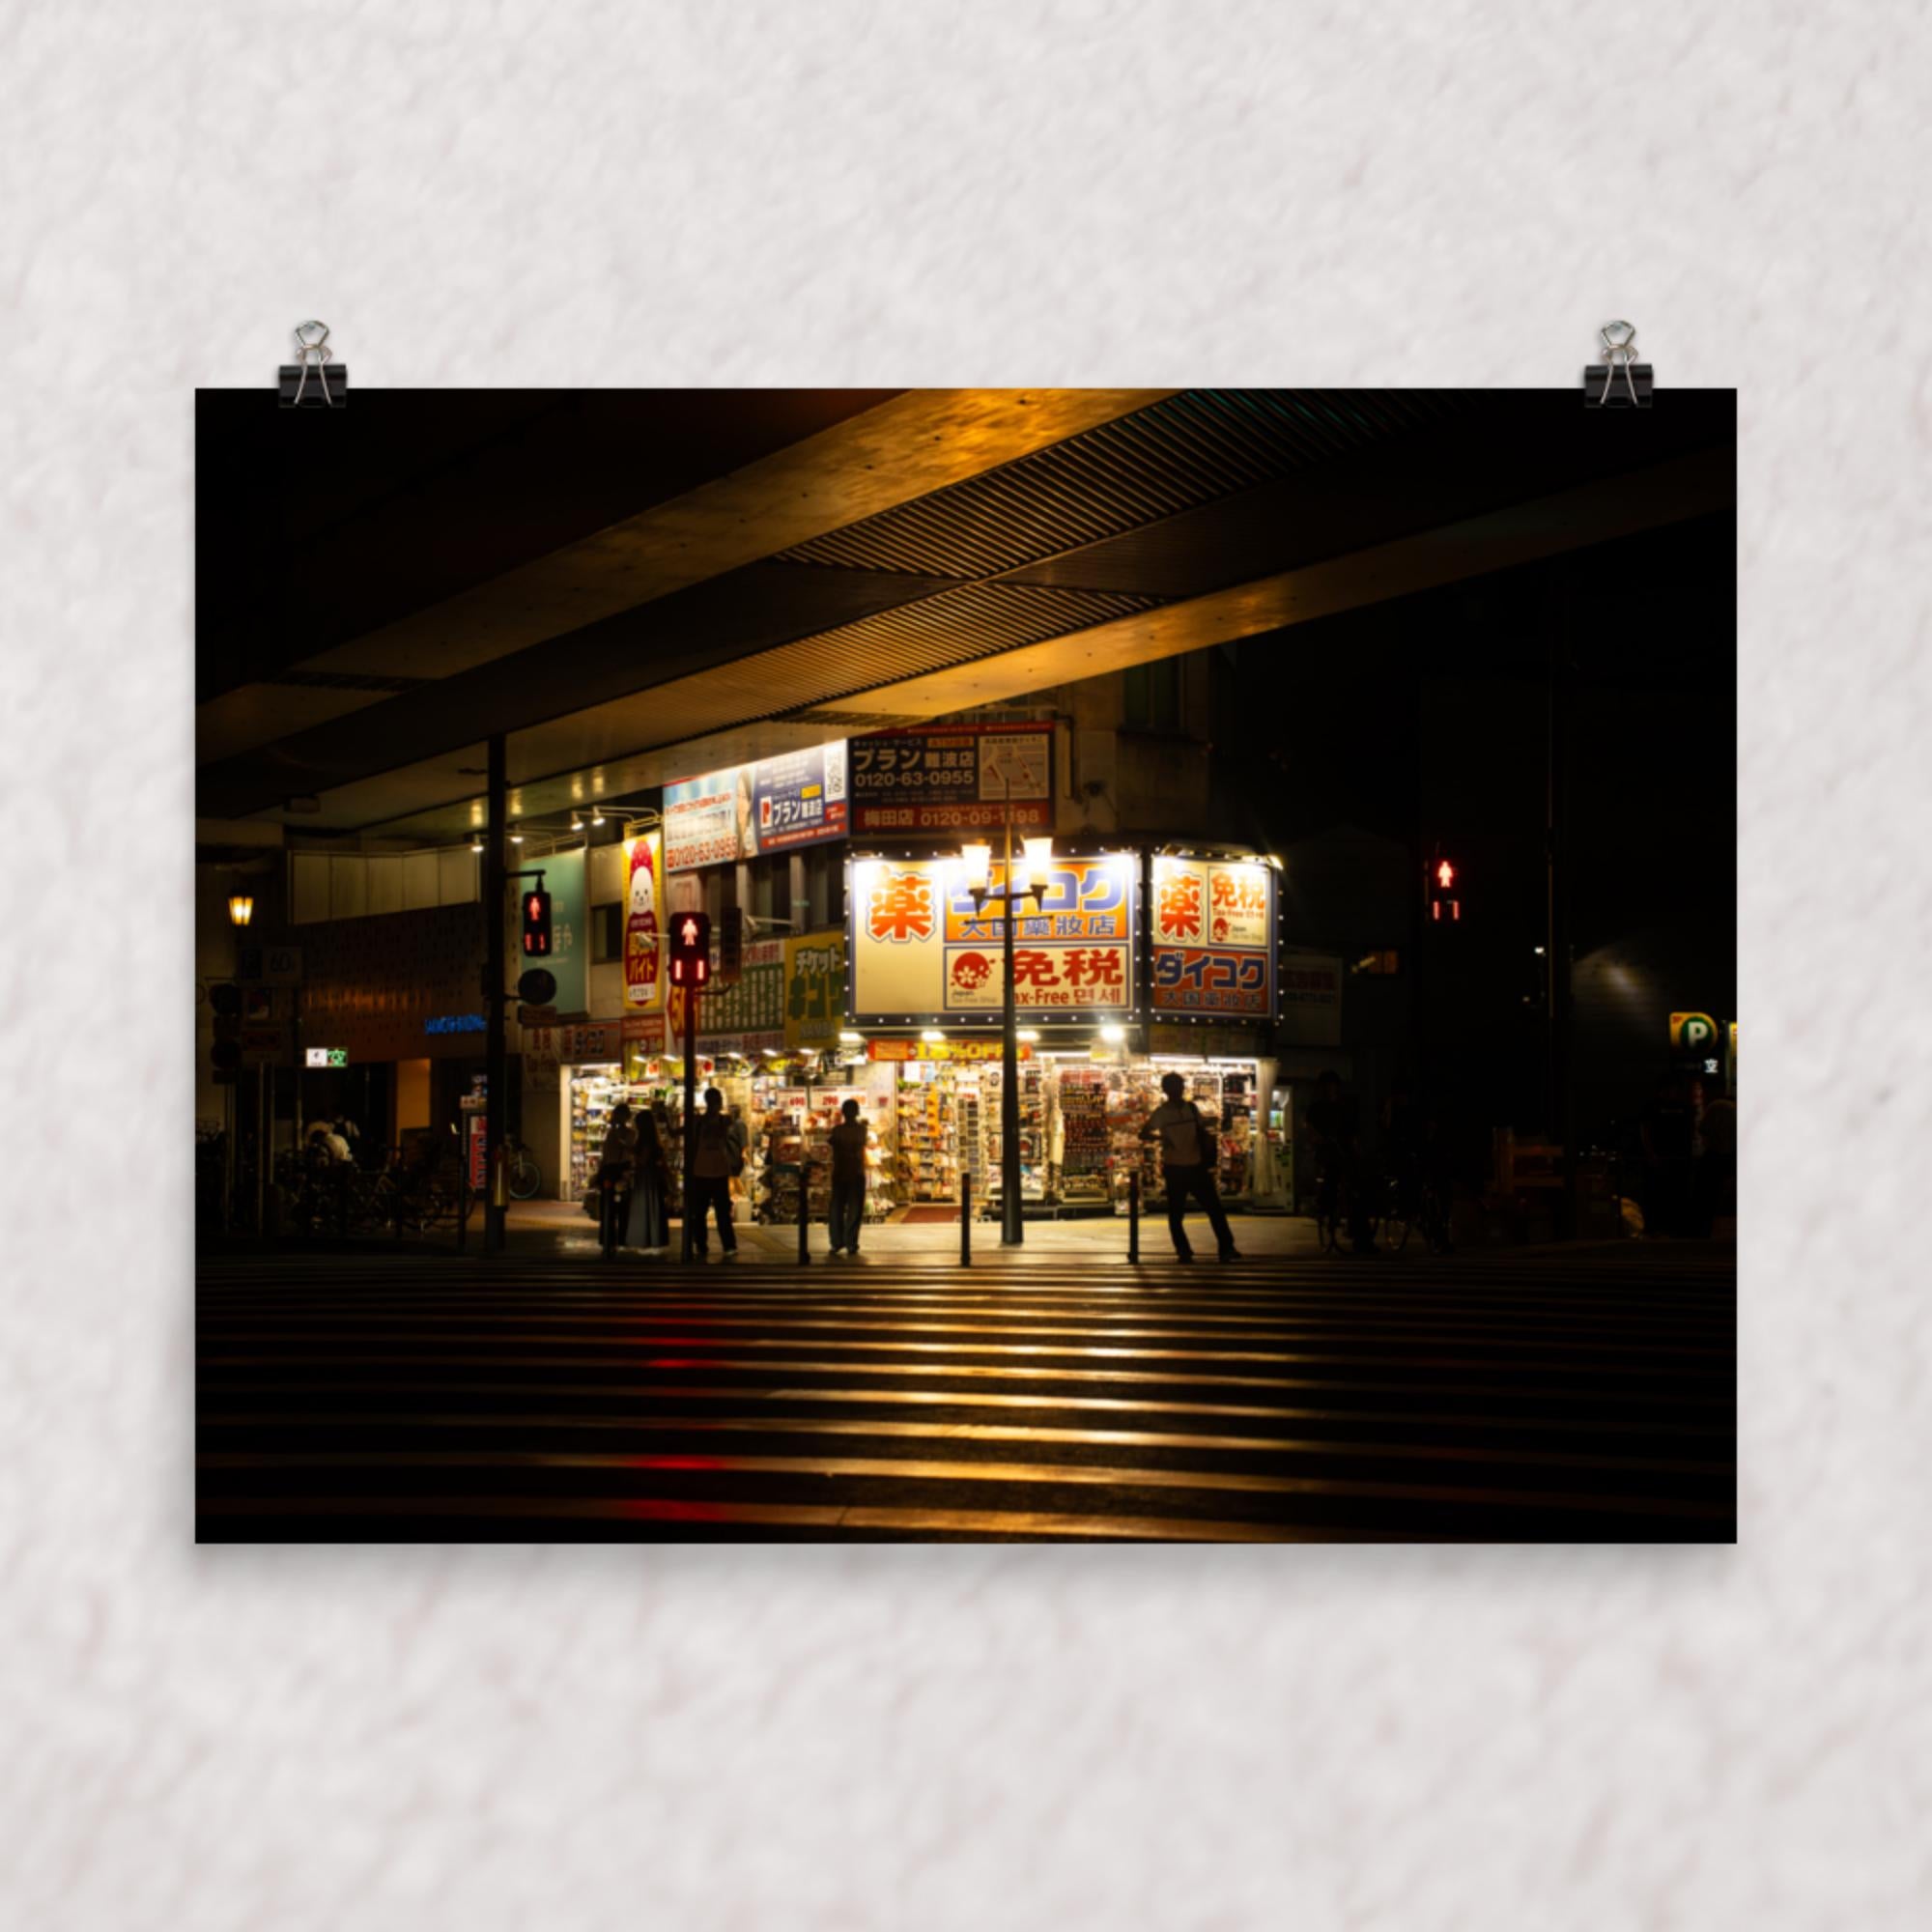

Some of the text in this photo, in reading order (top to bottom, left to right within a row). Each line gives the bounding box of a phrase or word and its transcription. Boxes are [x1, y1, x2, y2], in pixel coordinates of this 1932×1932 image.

[854, 771, 975, 788] 0120-63-0955
[869, 873, 933, 942] 薬
[1160, 875, 1202, 938] 薬
[1002, 949, 1123, 986] 免税
[1156, 951, 1265, 990] ダイコク
[1006, 987, 1070, 1006] ax-Free
[1688, 1021, 1709, 1048] P
[1703, 1058, 1719, 1073] 空
